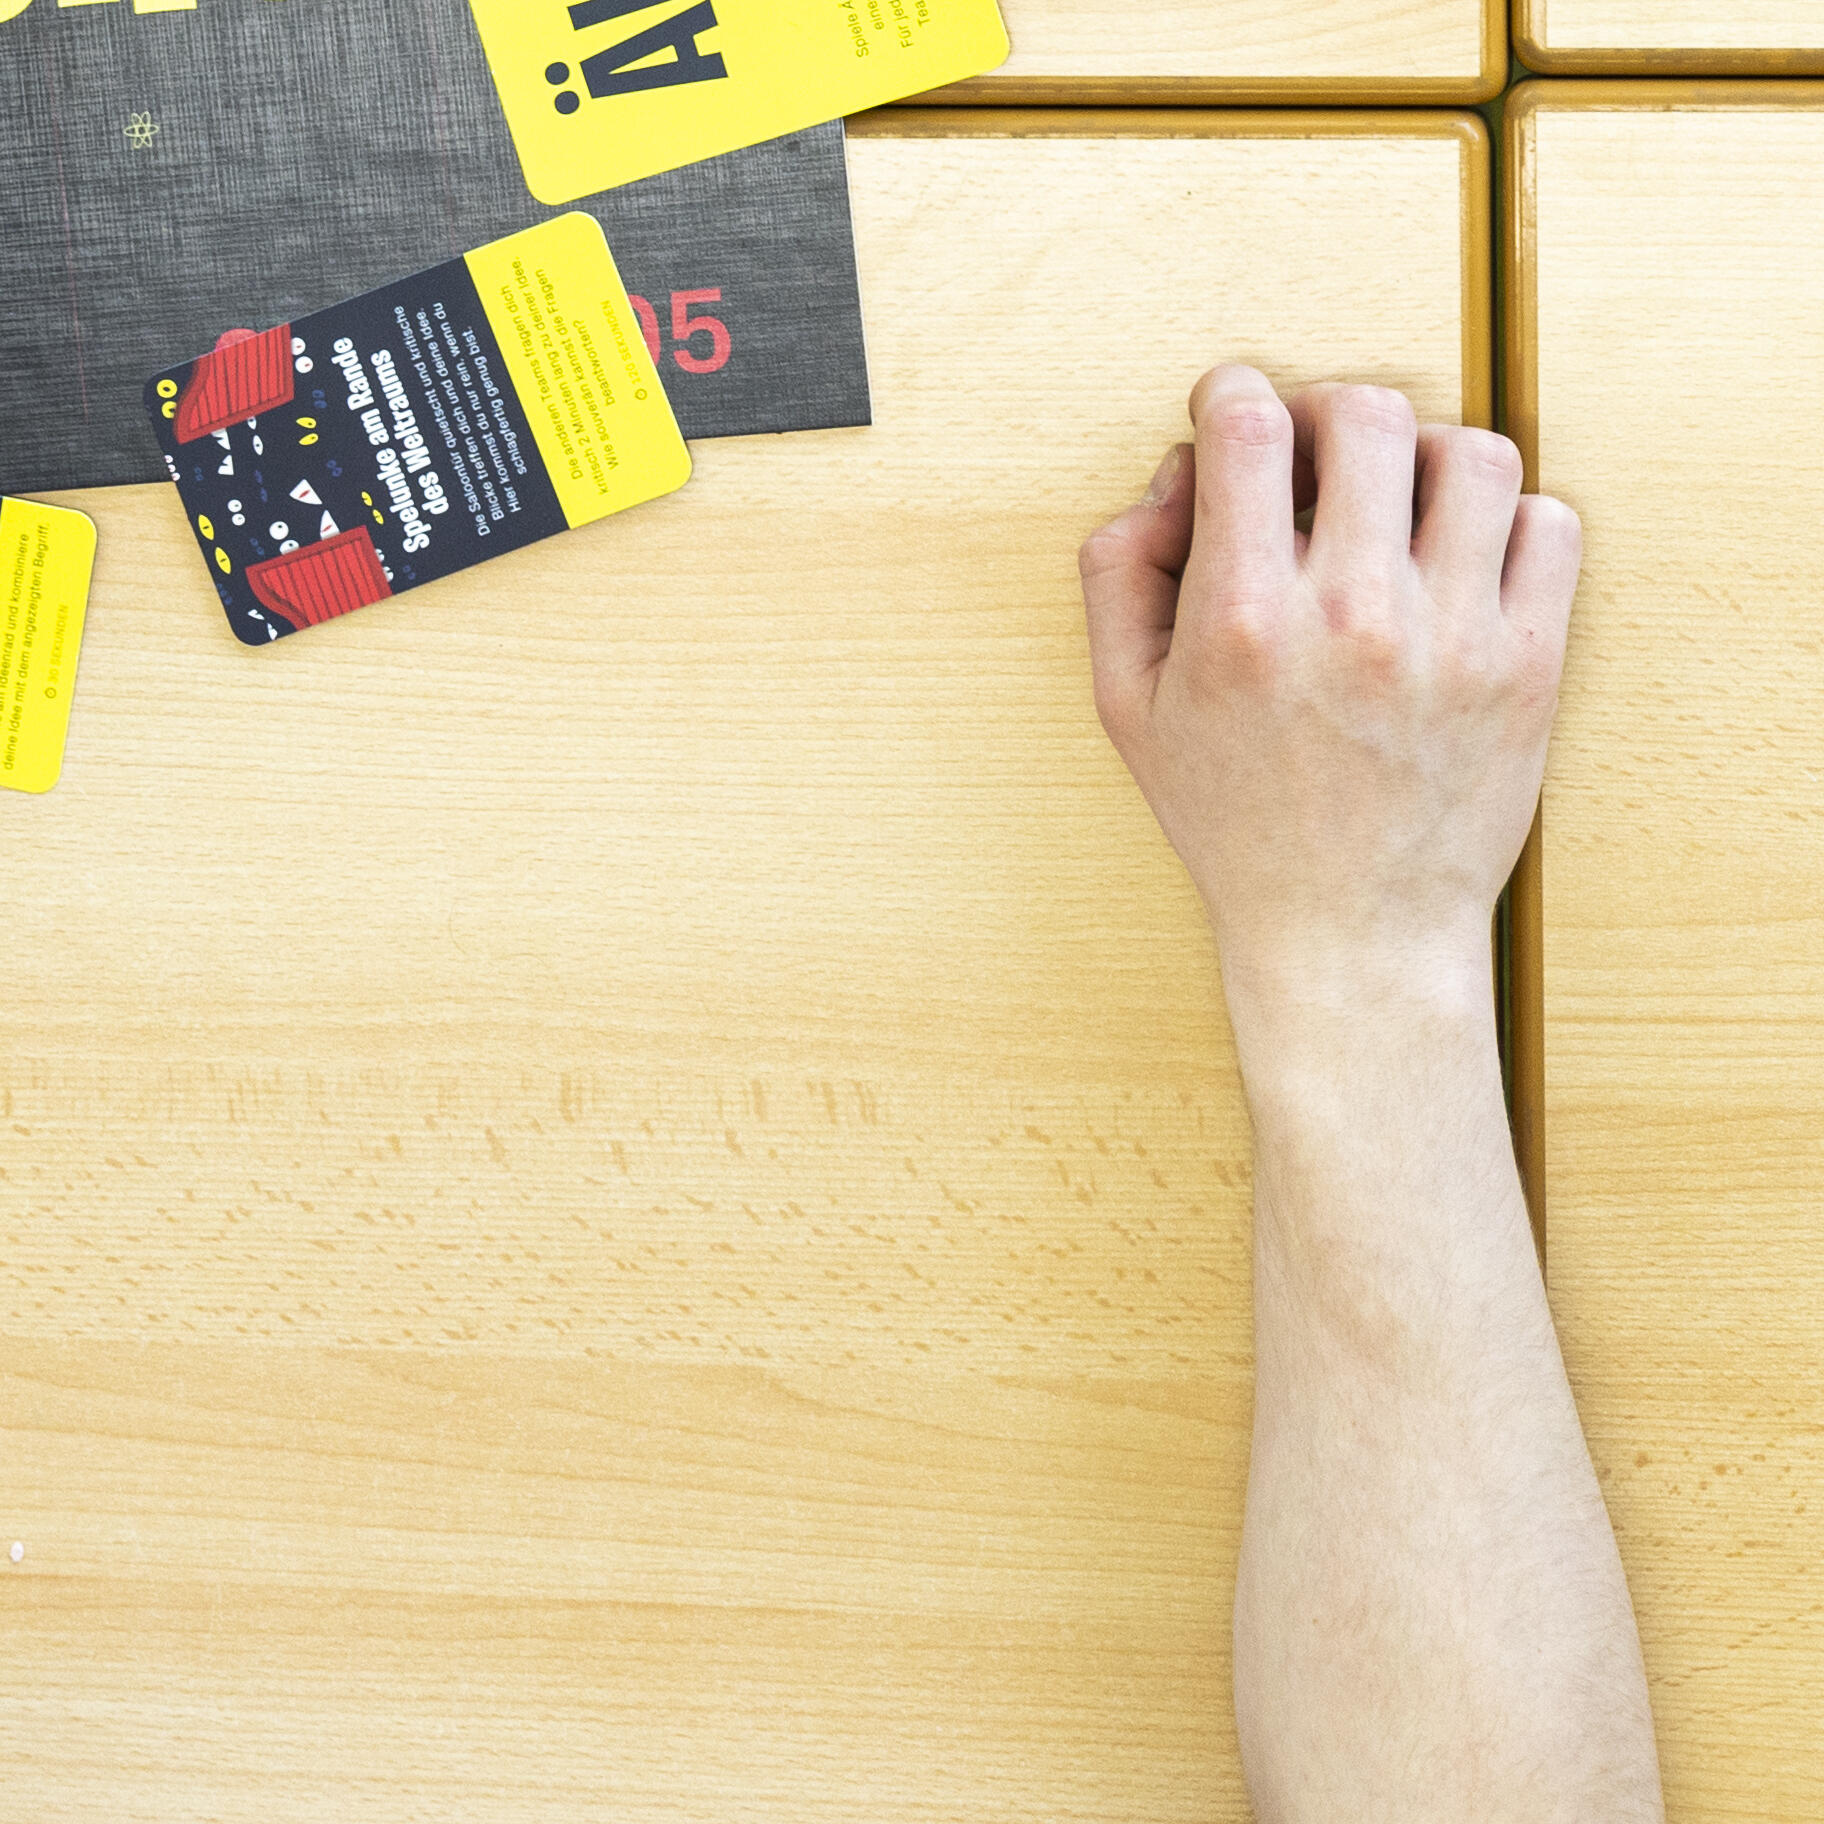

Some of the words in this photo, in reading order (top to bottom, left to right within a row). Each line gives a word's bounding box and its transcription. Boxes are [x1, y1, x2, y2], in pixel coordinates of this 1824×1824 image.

[848, 14, 869, 58] Spiele
[501, 286, 518, 313] dich
[394, 305, 422, 361] kritische
[416, 308, 434, 340] Idee.
[513, 316, 534, 358] fragen
[331, 337, 374, 411] Rande
[413, 361, 432, 387] und
[428, 341, 449, 377] deine
[440, 379, 460, 404] und
[530, 359, 551, 402] Teams
[358, 406, 390, 447] am
[371, 349, 431, 473] Weltraums
[424, 388, 457, 448] quietscht
[452, 406, 471, 434] dich
[547, 404, 574, 455] anderen
[465, 436, 489, 480] treffen
[569, 459, 583, 480] Die
[376, 448, 432, 553] Spelunke
[418, 471, 449, 515] des
[450, 451, 481, 513] Saloontür
[482, 481, 505, 521] Blicke
[475, 514, 491, 536] Die
[9, 533, 29, 603] kombiniere
[8, 605, 19, 630] und
